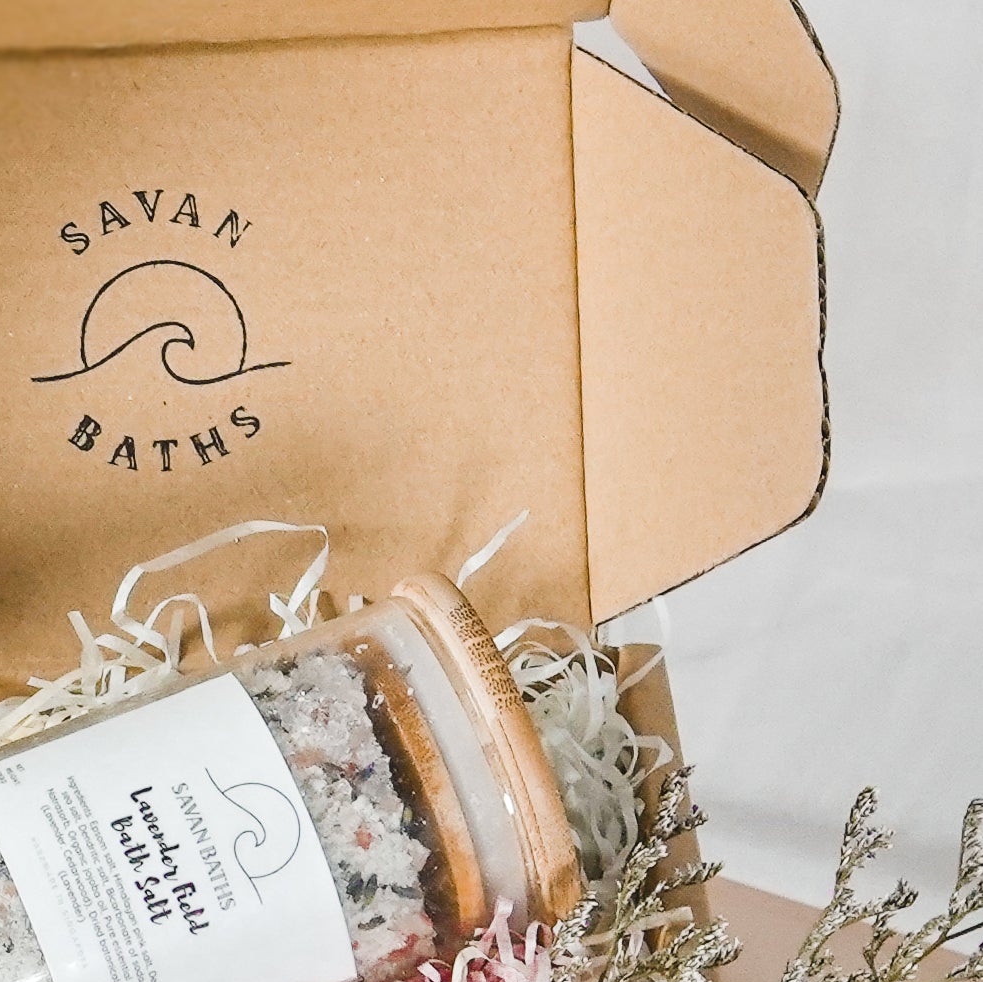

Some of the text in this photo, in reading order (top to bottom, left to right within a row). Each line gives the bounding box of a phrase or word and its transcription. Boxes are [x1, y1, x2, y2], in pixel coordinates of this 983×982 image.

[60, 190, 252, 255] SAVAN
[68, 406, 260, 471] BATHS
[111, 815, 172, 924] Bath Salt
[130, 786, 210, 935] Lavender Field
[171, 782, 236, 911] SAVAN BATHS
